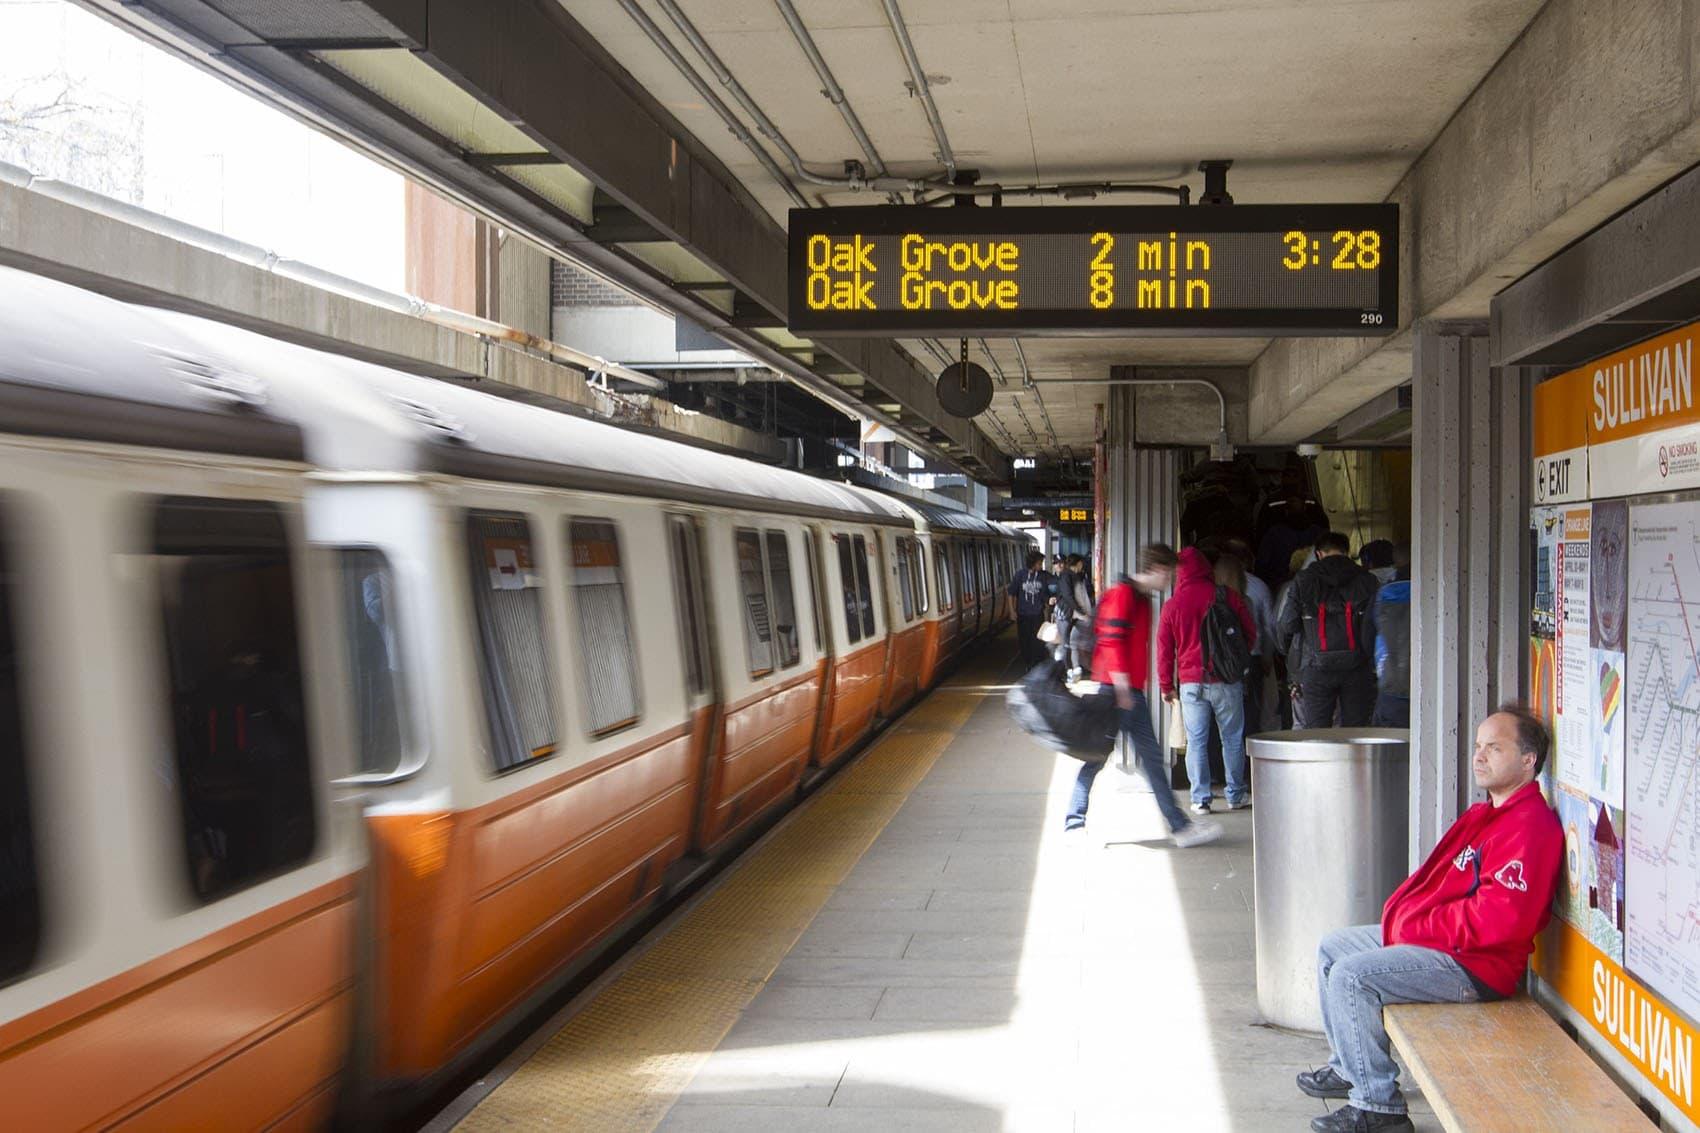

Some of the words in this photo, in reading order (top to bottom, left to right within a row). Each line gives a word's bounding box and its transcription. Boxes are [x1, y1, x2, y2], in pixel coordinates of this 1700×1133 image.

[807, 234, 877, 271] Oak
[901, 234, 1019, 271] Grove
[1091, 232, 1114, 271] 2
[1138, 232, 1211, 271] min
[1283, 231, 1380, 270] 3:28
[807, 271, 877, 310] Oak
[901, 271, 1019, 310] Grove
[1090, 271, 1114, 309] 8
[1138, 271, 1211, 309] min
[1360, 313, 1383, 325] 290
[1593, 338, 1692, 432] SULLIVAN
[1549, 458, 1571, 496] EXIT
[1592, 959, 1692, 1107] SULLIVAN
